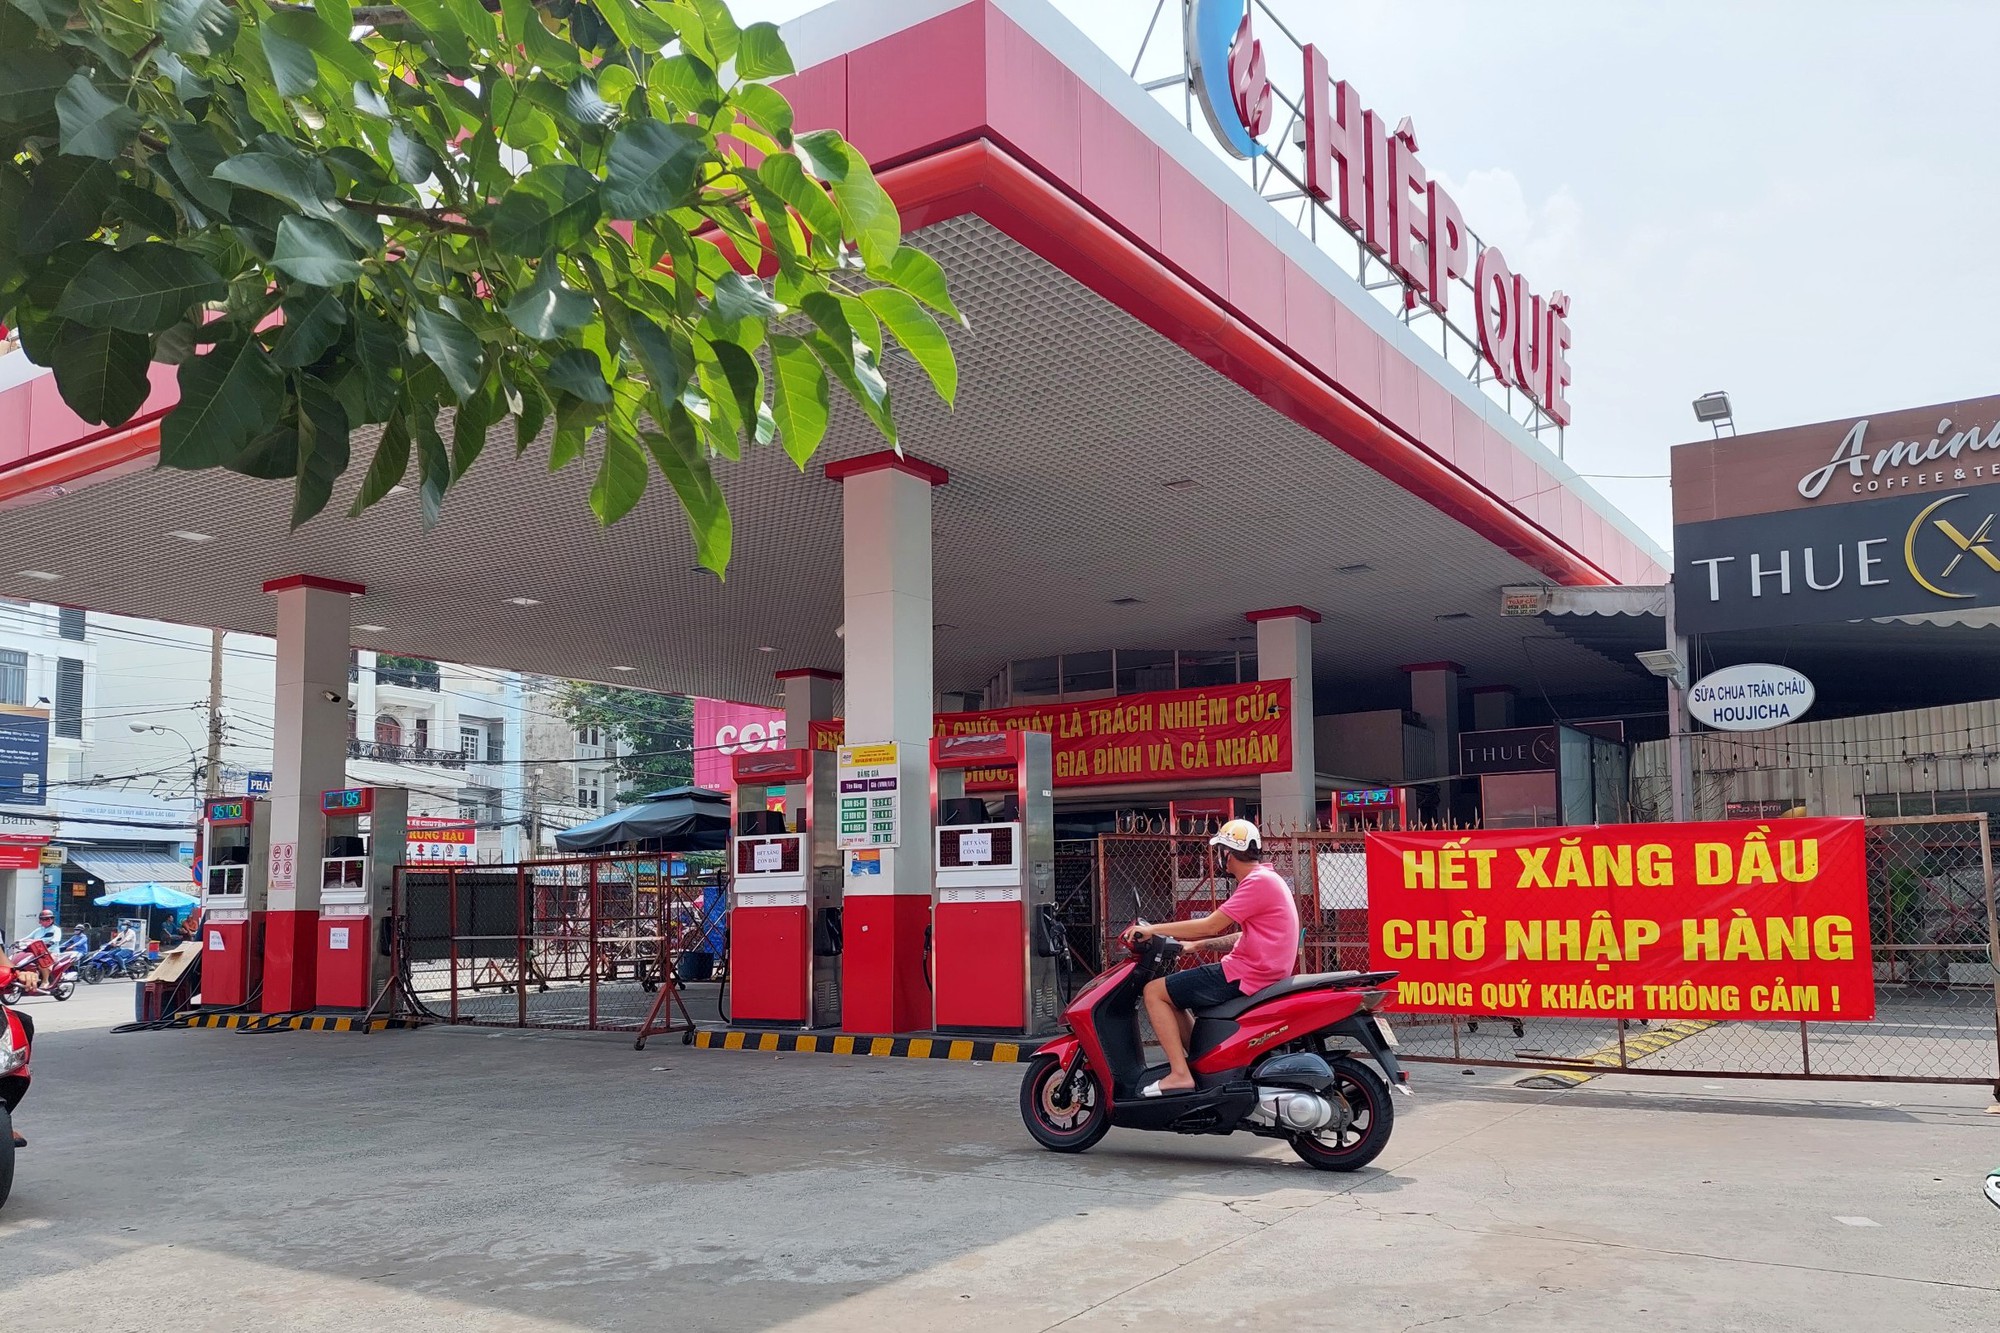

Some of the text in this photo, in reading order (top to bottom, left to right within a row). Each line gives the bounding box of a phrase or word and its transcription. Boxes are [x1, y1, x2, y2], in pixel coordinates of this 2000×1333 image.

[1303, 43, 1571, 428] HIỆP QUẾ
[1691, 538, 1890, 601] THUE
[1694, 677, 1806, 702] SỮA CHUA TRÂN CHÂU
[1060, 707, 1083, 738] LÀ
[1088, 702, 1152, 736] TRÁCH
[1159, 694, 1228, 733] NHIỆM
[1235, 684, 1280, 723] CỦA
[1713, 703, 1790, 722] HOUJICHA
[1056, 750, 1088, 777] GIA
[1094, 743, 1142, 775] ĐÌNH
[1148, 738, 1175, 771] VÀ
[1180, 735, 1209, 769] CÁ
[1215, 730, 1278, 767] NHÂN
[1465, 744, 1528, 762] THUE
[213, 805, 242, 818] 95 DO
[345, 792, 359, 806] 95
[1346, 792, 1386, 803] 95 95
[1402, 825, 1819, 889] HẾT XĂNG DẦU
[1382, 908, 1854, 971] CHỜ NHẬP HÀNG
[1398, 981, 1473, 1007] MONG
[1481, 978, 1532, 1010] QUÝ
[1541, 979, 1634, 1010] KHÁCH
[1643, 979, 1740, 1011] THÔNG
[1750, 976, 1820, 1012] CẢM
